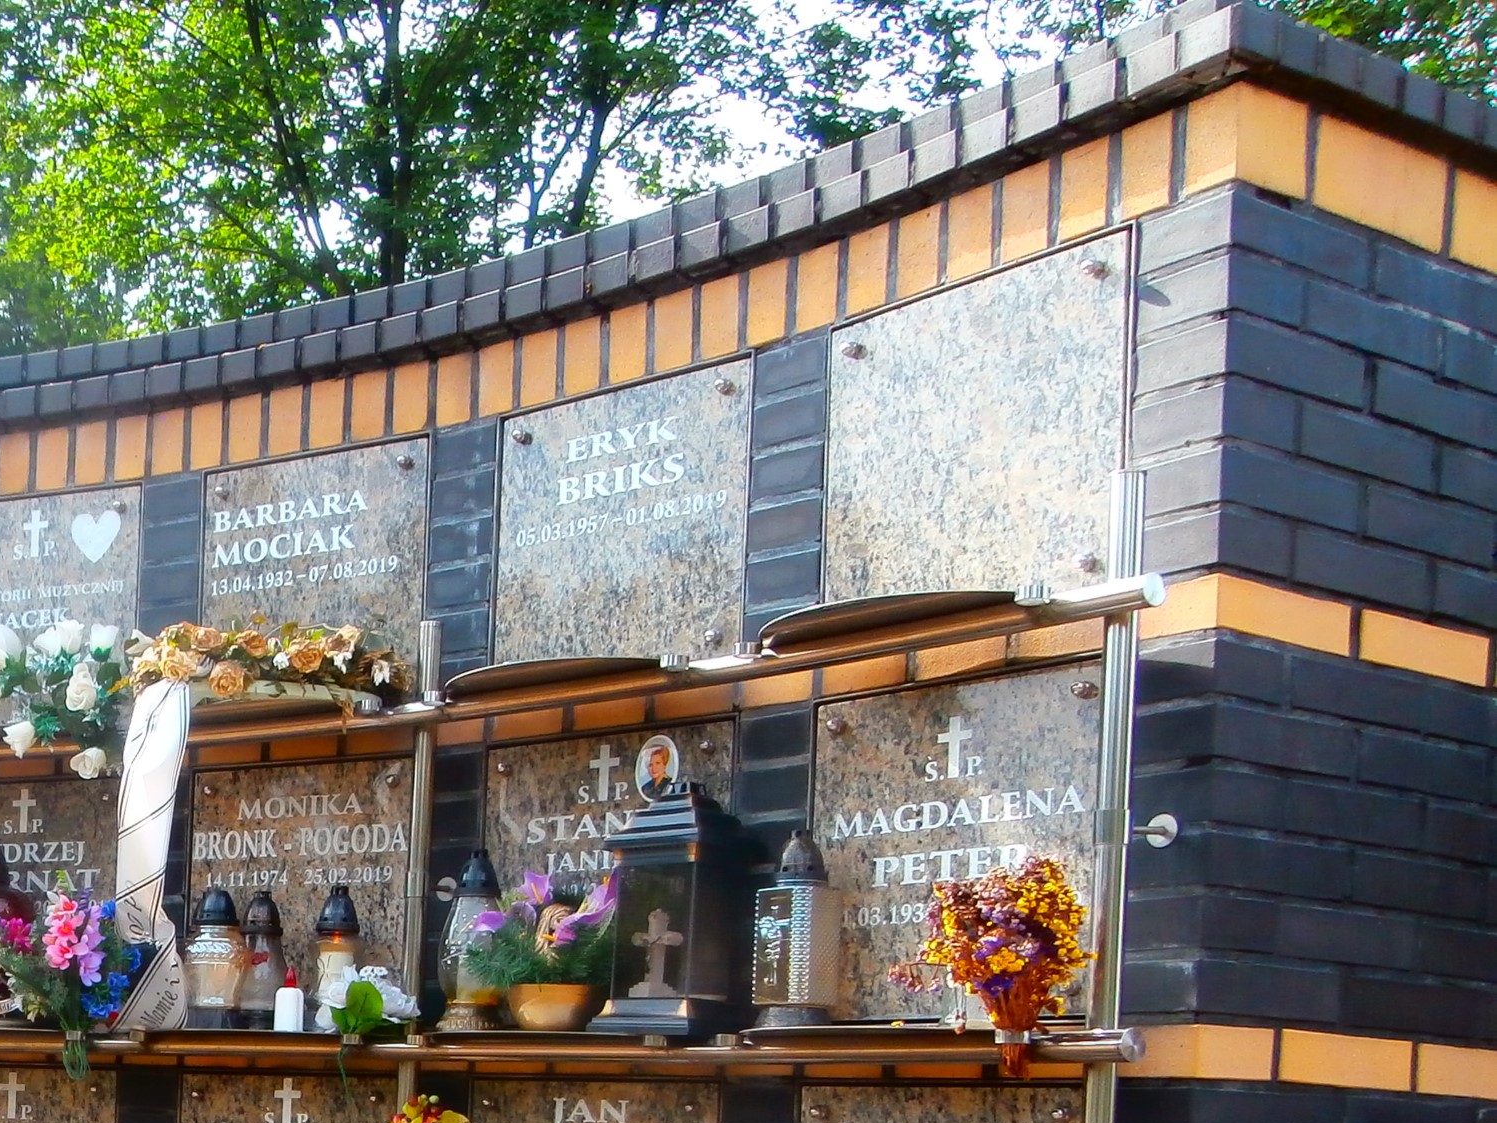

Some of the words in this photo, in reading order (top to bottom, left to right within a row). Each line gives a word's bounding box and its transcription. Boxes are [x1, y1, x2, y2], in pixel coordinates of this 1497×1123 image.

[566, 415, 678, 464] ERYK
[556, 451, 686, 507] BRIKS
[212, 488, 369, 535] BARBARA
[516, 514, 609, 548] 05.03.1957
[626, 488, 728, 527] 01.08.2019
[210, 522, 356, 570] MOCIAK
[210, 569, 294, 598] 13.04.1932
[308, 554, 399, 584] 07.08.2019
[237, 792, 365, 822] MONIKA
[832, 785, 1087, 841] MAGDALENA
[193, 828, 278, 860] BRONK
[298, 822, 409, 857] POGODA
[205, 869, 289, 889] 14.11.1974
[304, 865, 394, 886] 25.02.2019
[871, 844, 1028, 888] PETER
